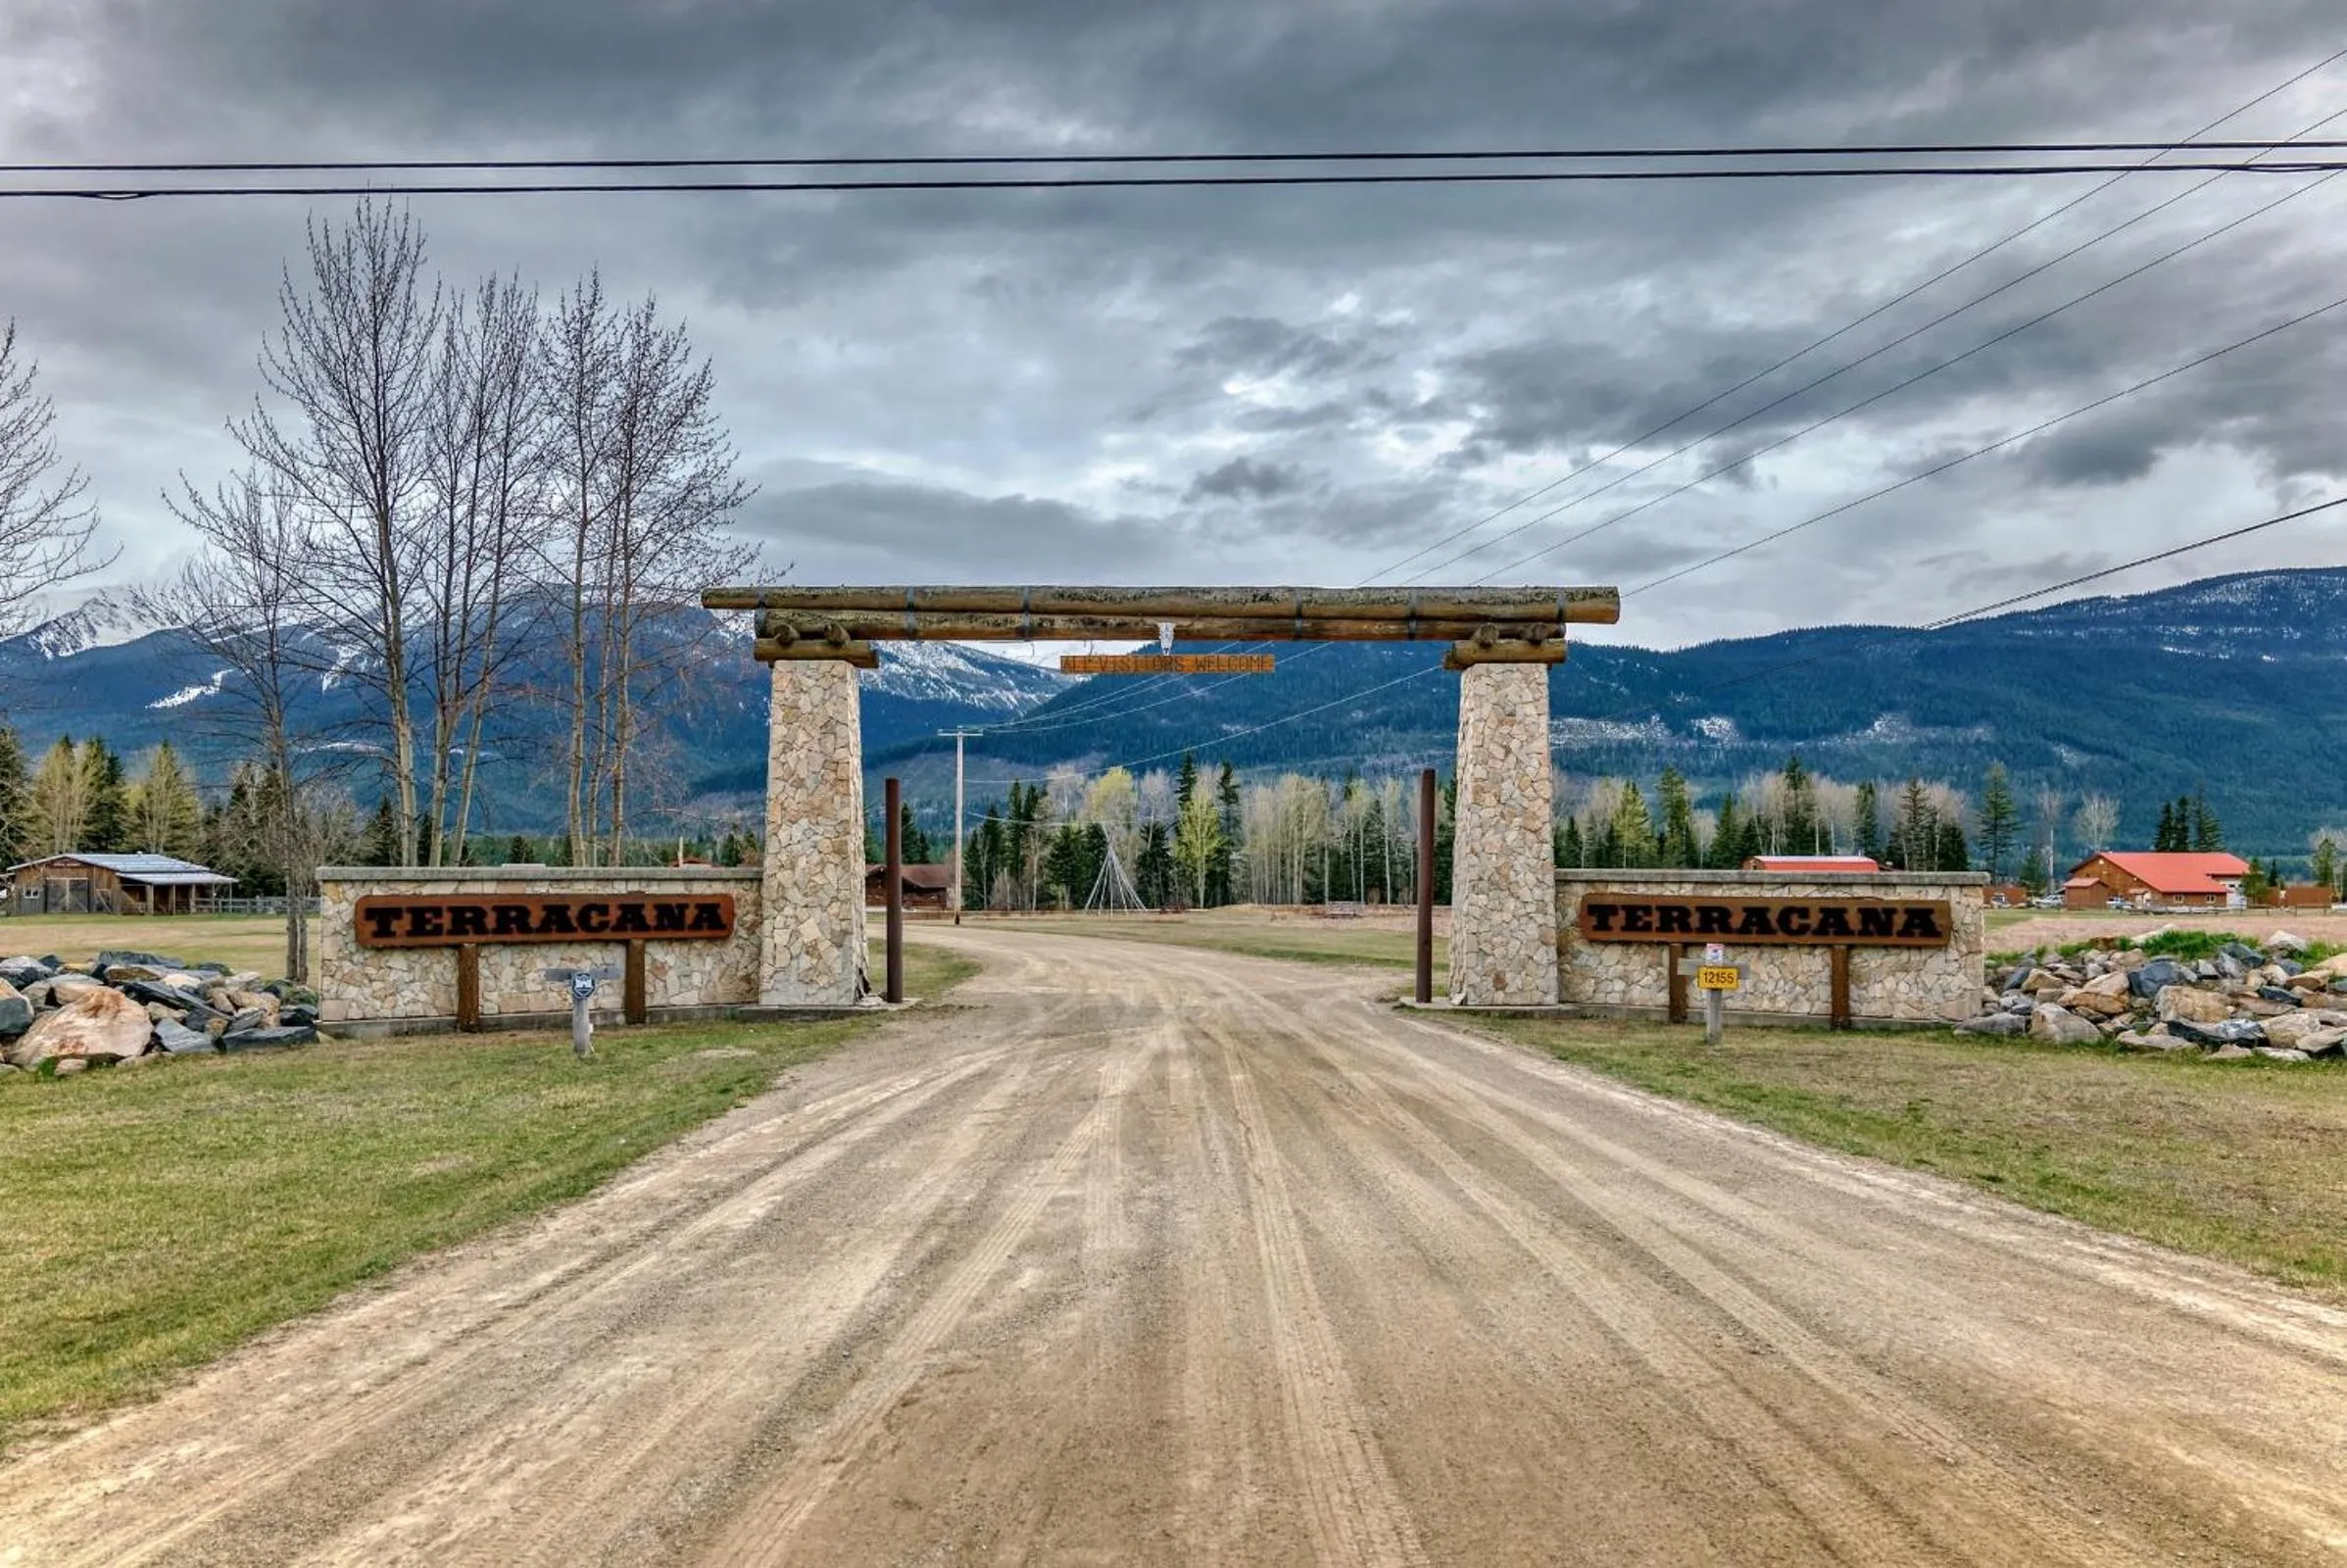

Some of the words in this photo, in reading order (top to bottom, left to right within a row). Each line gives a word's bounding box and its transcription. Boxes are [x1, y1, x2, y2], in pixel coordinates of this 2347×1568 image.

[1099, 656, 1185, 672] VISITORS
[1195, 655, 1271, 672] WELCOME
[365, 903, 728, 938] TERRACANA
[1587, 904, 1943, 938] TERRACANA
[1703, 971, 1735, 984] 12155
